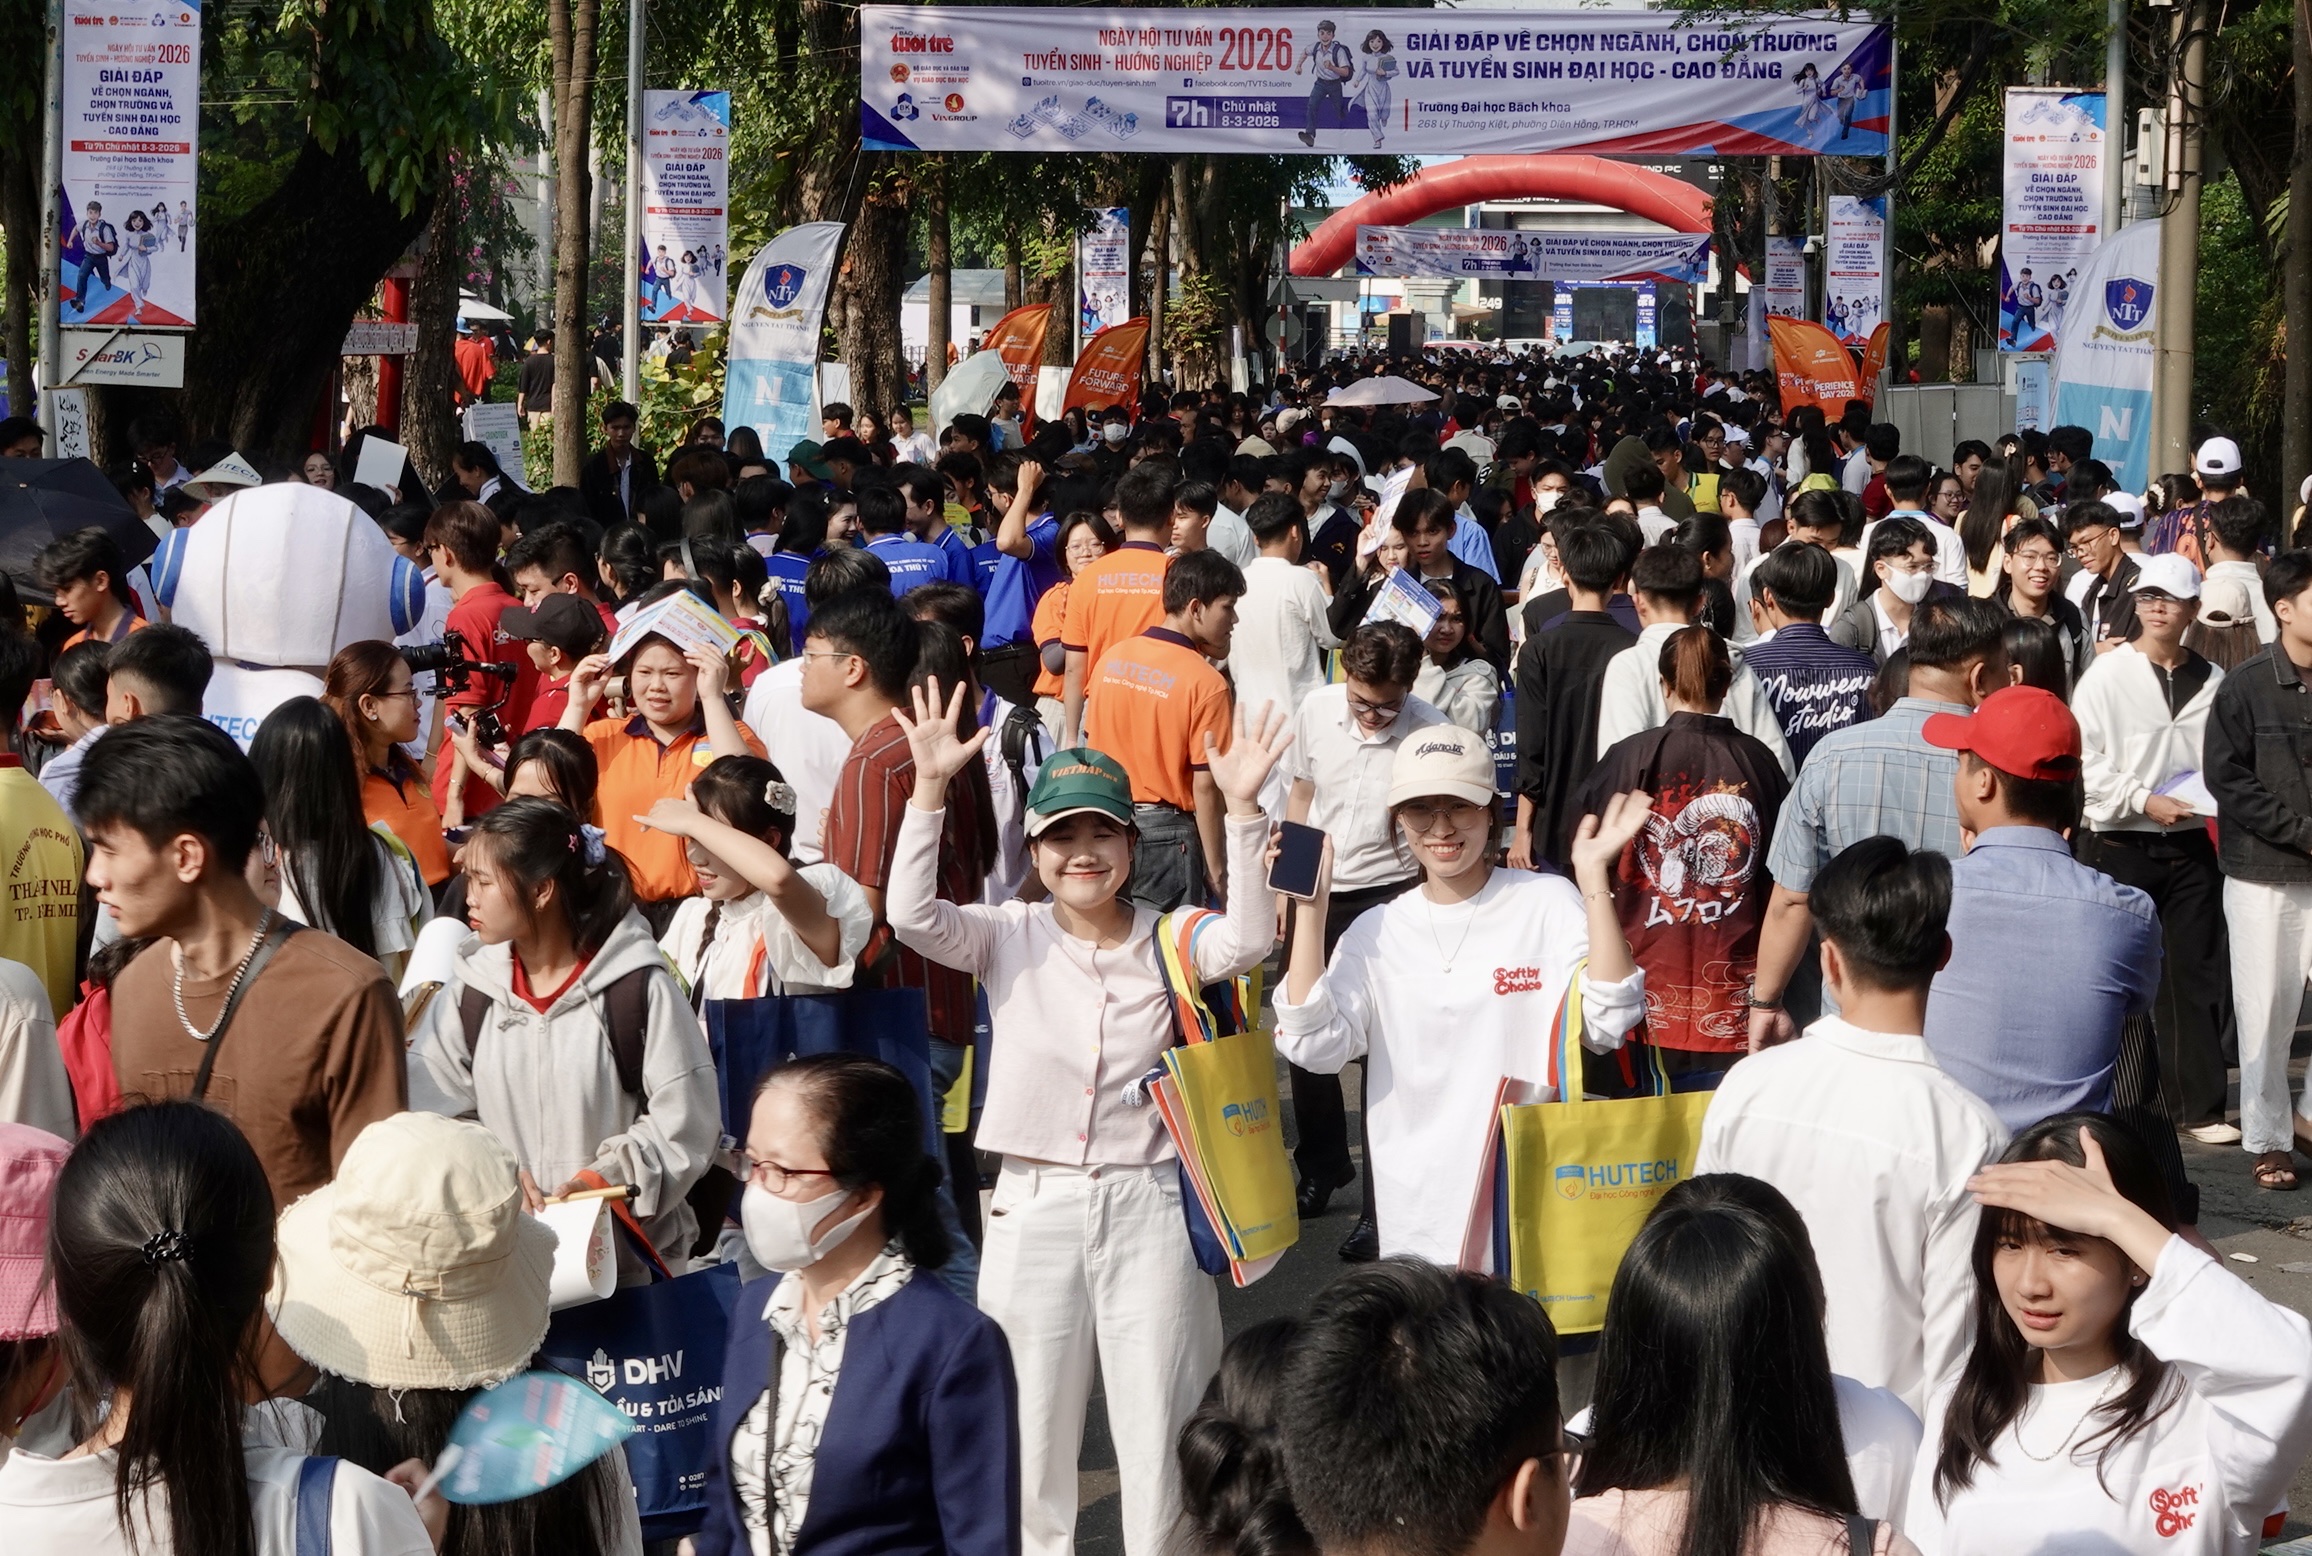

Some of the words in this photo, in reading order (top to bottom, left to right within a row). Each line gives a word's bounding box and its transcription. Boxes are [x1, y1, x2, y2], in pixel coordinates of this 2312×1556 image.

[890, 32, 926, 53] tuổi
[928, 33, 954, 53] trẻ
[1099, 28, 1136, 46] NGÀY
[1139, 27, 1161, 50] HỘI
[1164, 29, 1184, 46] TƯ
[1185, 25, 1213, 47] VẤN
[1406, 29, 1450, 51] GIẢI
[1454, 30, 1499, 51] ĐÁP
[1504, 27, 1531, 51] VỀ
[1536, 33, 1595, 55] CHỌN
[1600, 30, 1682, 54] NGÀNH,
[1687, 34, 1749, 55] CHỌN
[1752, 30, 1838, 52] TRƯỜNG
[158, 44, 190, 64] 2026
[1218, 27, 1293, 71] 2026
[1023, 47, 1068, 71] TUYỂN
[1070, 53, 1102, 71] SINH
[1114, 51, 1160, 71] HƯỚNG
[1164, 52, 1213, 75] NGHIỆP
[99, 67, 129, 83] GIẢI
[132, 68, 163, 83] ĐÁP
[1406, 57, 1435, 79] VÀ
[1439, 54, 1507, 79] TUYỂN
[1512, 61, 1563, 79] SINH
[1567, 61, 1605, 83] ĐẠI
[1610, 62, 1655, 83] HỌC
[1672, 62, 1716, 79] CAO
[1721, 54, 1782, 79] ĐẲNG
[1194, 78, 1293, 88] facebook.com/TVTS.tuoitre
[92, 84, 104, 96] VỀ
[105, 87, 132, 98] CHỌN
[134, 86, 172, 99] NGÀNH,
[90, 100, 116, 111] CHỌN
[118, 100, 158, 110] TRƯỜNG
[160, 100, 174, 110] VÀ
[1221, 100, 1253, 113] Chủ
[1256, 100, 1277, 113] nhật
[1418, 101, 1458, 115] Trường
[1460, 102, 1481, 115] Đại
[1483, 101, 1506, 115] học
[1508, 101, 1538, 113] Bách
[1541, 102, 1571, 113] khoa
[83, 111, 114, 123] TUYỂN
[115, 113, 138, 123] SINH
[140, 114, 158, 125] ĐẠI
[160, 115, 181, 125] HỌC
[932, 114, 978, 122] VINGROUP
[1171, 100, 1209, 127] 7h
[1221, 116, 1280, 128] 8-3-2026
[1418, 119, 1438, 129] 268
[1439, 119, 1450, 130] Lý
[1452, 119, 1486, 131] Thường
[1488, 119, 1510, 130] Kiệt,
[1512, 119, 1548, 131] phường
[1550, 119, 1572, 129] Diên
[1574, 117, 1601, 130] Hồng,
[1603, 119, 1639, 129] TP.HCM
[108, 126, 128, 136] CAO
[130, 123, 159, 136] ĐẲNG
[141, 143, 180, 152] 8-3-2026
[702, 148, 723, 160] 2026
[665, 161, 684, 172] GIẢI
[2074, 155, 2097, 169] 2026
[2032, 171, 2054, 183] GIẢI
[2056, 172, 2078, 183] ĐÁP
[2036, 186, 2056, 194] CHỌN
[2024, 195, 2044, 203] CHỌN
[1481, 236, 1507, 250] 2026
[1582, 248, 1600, 256] SINH
[1464, 260, 1478, 270] 7h
[768, 284, 796, 302] NTT
[1479, 298, 1503, 309] 249
[2111, 303, 2144, 322] NTT
[2082, 341, 2116, 351] NGUYEN
[2117, 344, 2133, 353] TAT
[76, 348, 136, 364] SlarBK
[136, 370, 161, 378] Smarter
[1004, 364, 1032, 374] TURE
[1088, 368, 1126, 383] FUTURE
[1007, 374, 1038, 385] WARD
[1079, 377, 1130, 392] FORWARD
[755, 375, 783, 406] N
[1820, 390, 1836, 399] DAY
[1836, 389, 1856, 398] 2026
[2098, 405, 2134, 441] N
[904, 563, 921, 572] THÚ
[1097, 572, 1163, 586] HUTECH
[1104, 658, 1177, 690] HUTECH
[1784, 699, 1856, 738] studio
[1051, 765, 1103, 779] VIETMAP
[10, 840, 32, 879] TRƯỜNG
[15, 906, 33, 921] TP.
[1644, 892, 1745, 929] ムフロン
[1493, 967, 1527, 980] Soft
[1527, 966, 1540, 980] by
[1494, 979, 1542, 996] Choice
[1588, 1159, 1677, 1187] HUTECH
[1590, 1191, 1602, 1200] Đại
[1604, 1190, 1617, 1200] học
[1618, 1189, 1638, 1199] Công
[1639, 1188, 1655, 1199] nghệ
[623, 1349, 684, 1385] DHV
[616, 1396, 638, 1417] ẦU
[640, 1402, 654, 1417] &
[657, 1394, 685, 1416] TỎA
[686, 1386, 725, 1409] SÁN
[654, 1422, 677, 1433] DARE
[678, 1420, 686, 1428] TO
[686, 1412, 708, 1426] SHINE
[2149, 1486, 2199, 1514] Soft
